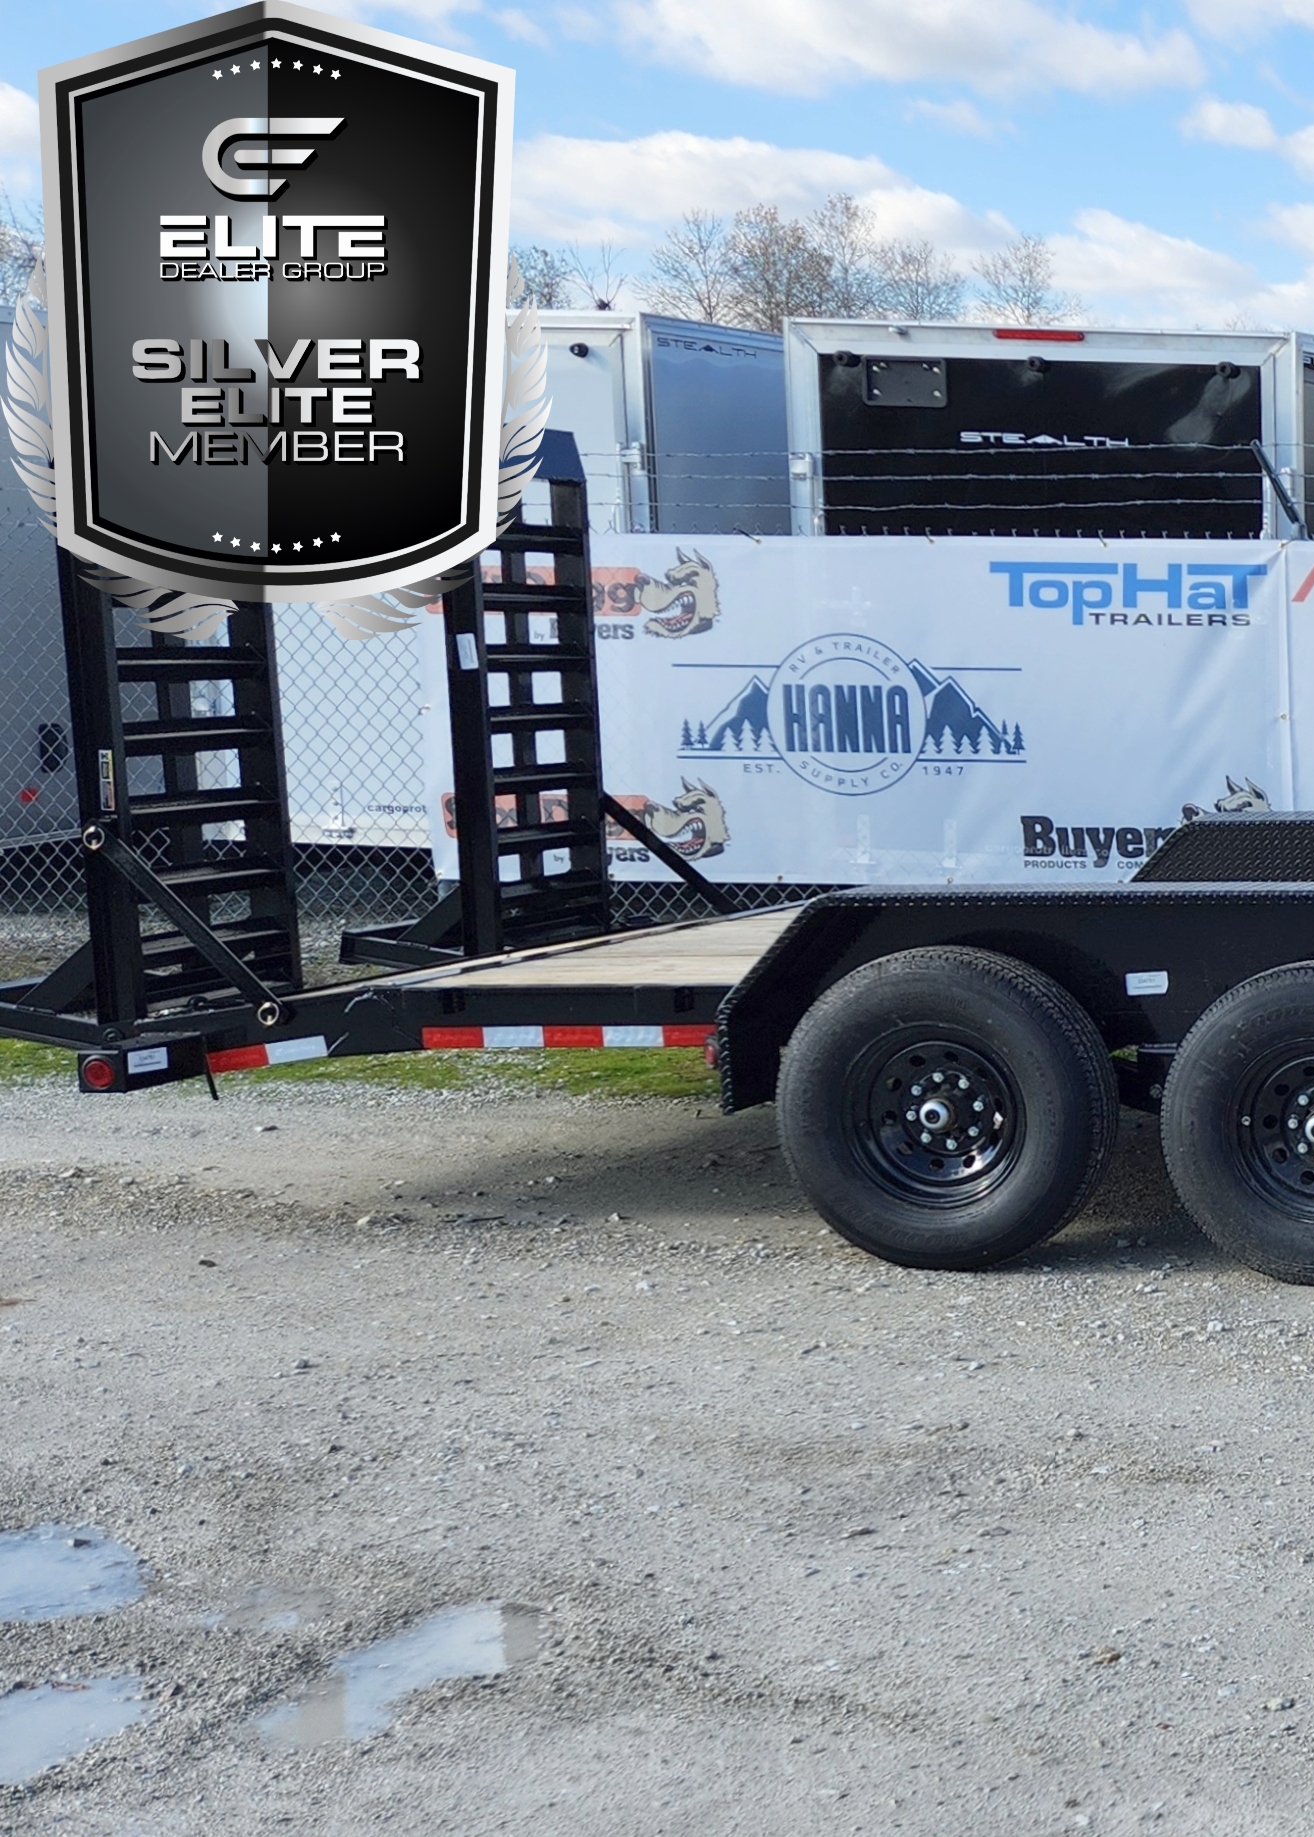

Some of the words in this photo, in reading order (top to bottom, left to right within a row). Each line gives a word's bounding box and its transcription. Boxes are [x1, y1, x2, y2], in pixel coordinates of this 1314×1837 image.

[657, 337, 757, 359] STEALTH
[960, 431, 1129, 447] STEALTH
[1090, 612, 1251, 627] TRAILERS
[789, 656, 806, 673] RV
[814, 646, 823, 655] &
[832, 641, 900, 674] TRAILER
[782, 684, 911, 753] HANNA
[743, 763, 780, 774] EST.
[799, 760, 869, 787] SUPPLY
[922, 766, 964, 776] 1947
[1020, 815, 1179, 868] Buyer
[1024, 860, 1087, 870] PRODUCTS
[1116, 860, 1145, 870] COM
